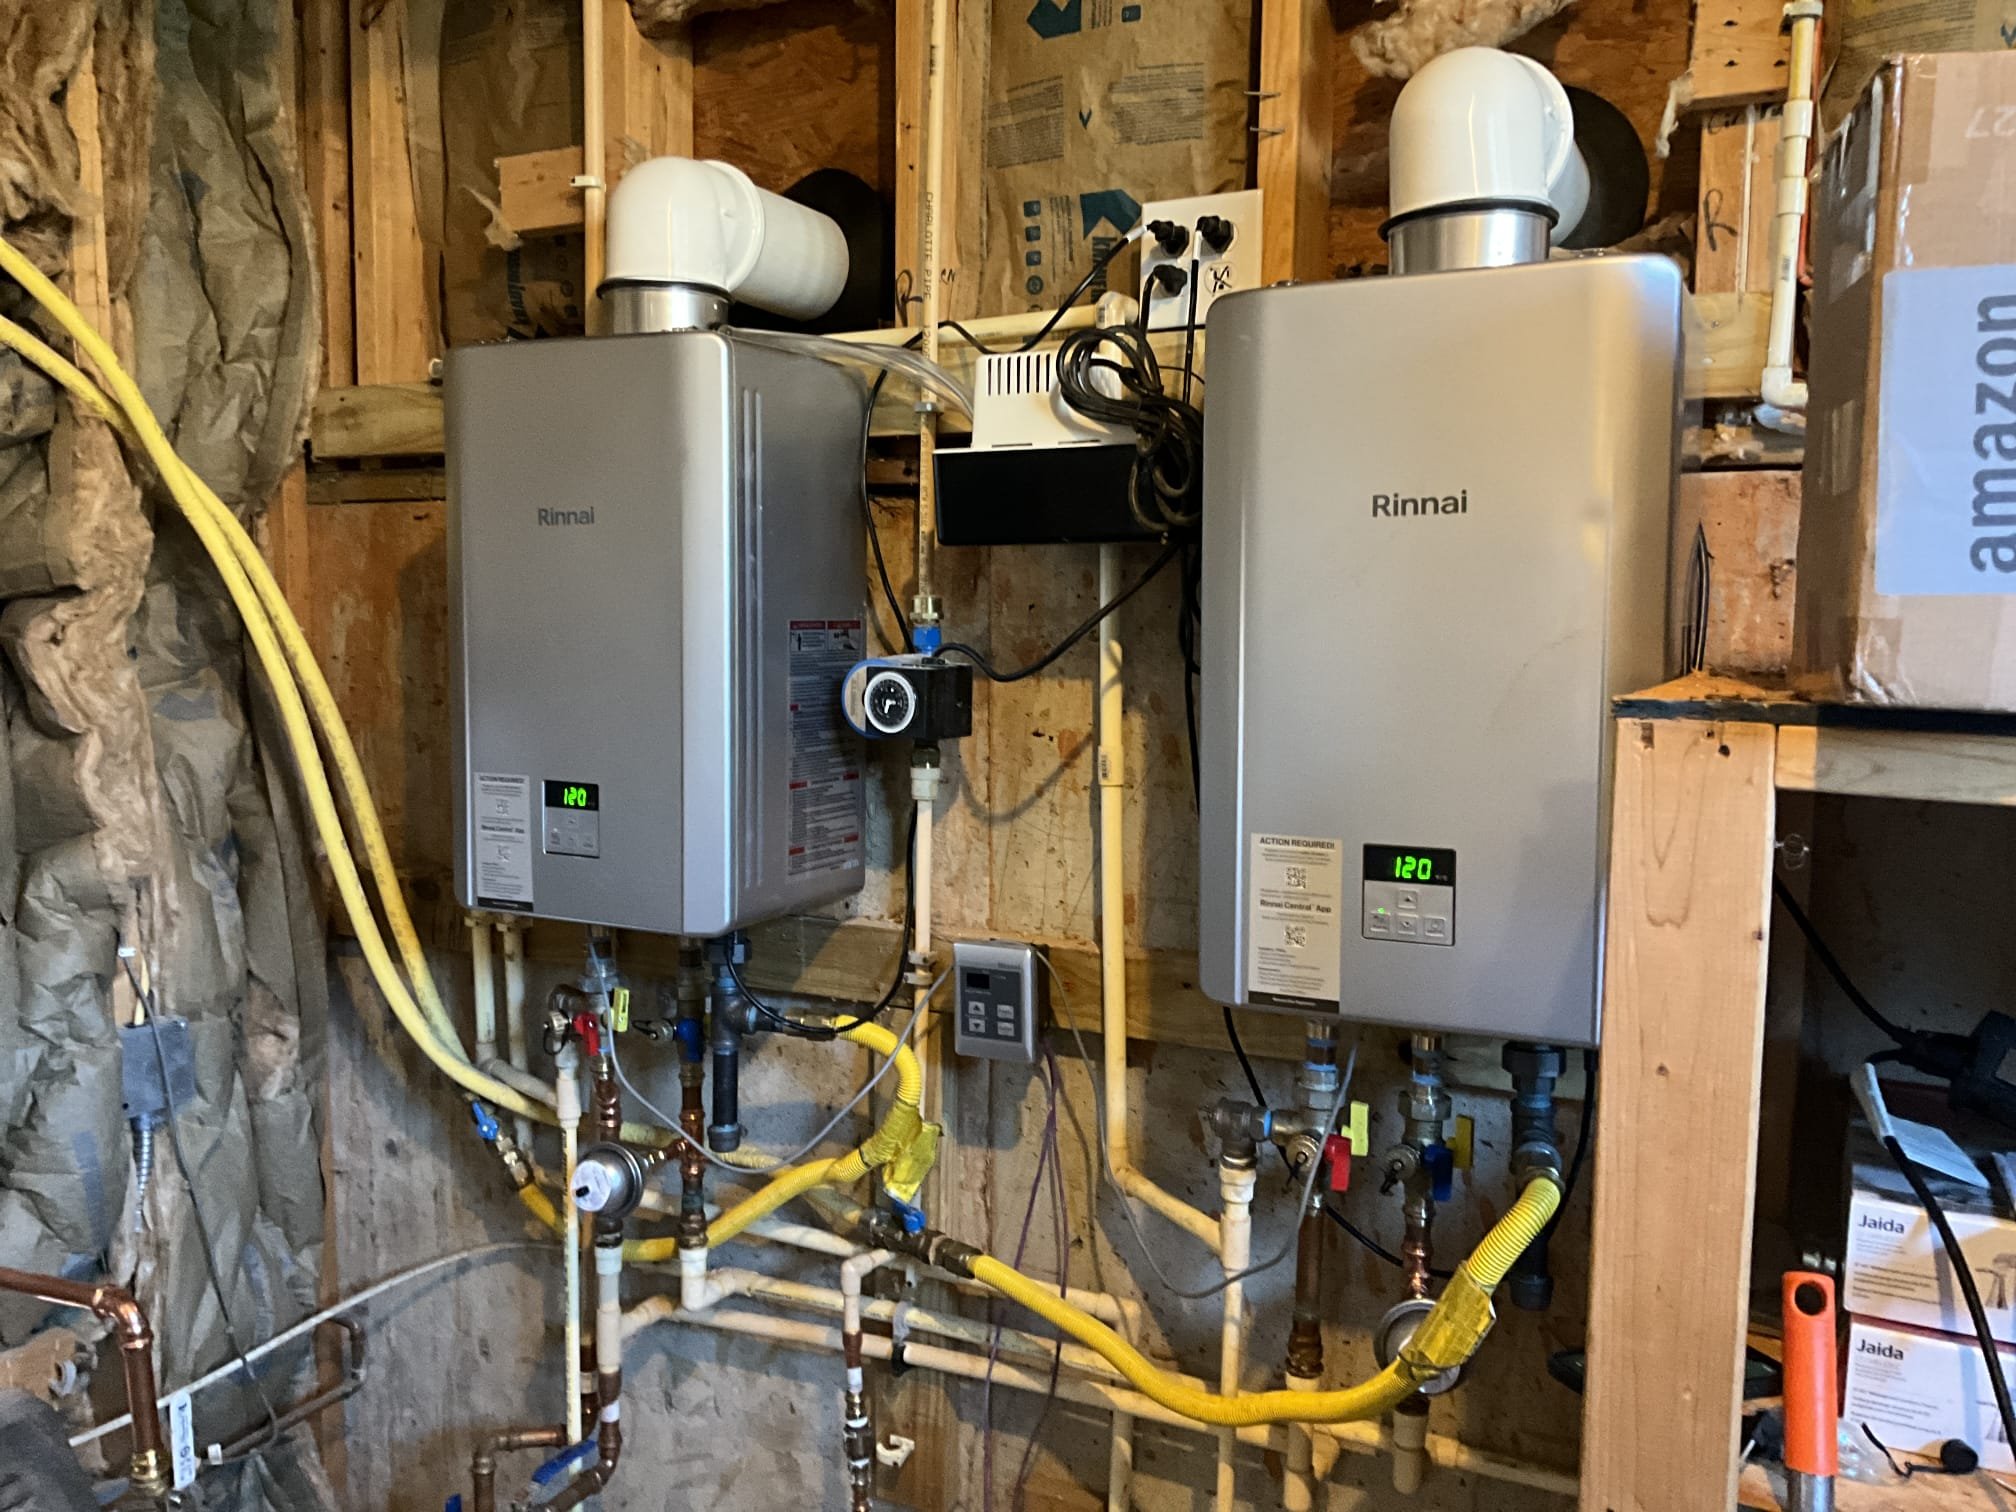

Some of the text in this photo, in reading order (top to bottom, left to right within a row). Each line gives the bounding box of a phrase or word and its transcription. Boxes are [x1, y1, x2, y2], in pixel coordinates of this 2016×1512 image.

[1969, 294, 2016, 574] amazon
[1371, 489, 1468, 518] Rinnai
[537, 505, 596, 526] Rinnai
[564, 786, 587, 807] 120
[1260, 837, 1291, 847] ACTION
[1395, 855, 1432, 880] 120
[1315, 905, 1332, 913] App
[1858, 1214, 1905, 1234] Jaida
[1856, 1339, 1904, 1361] Jaida
